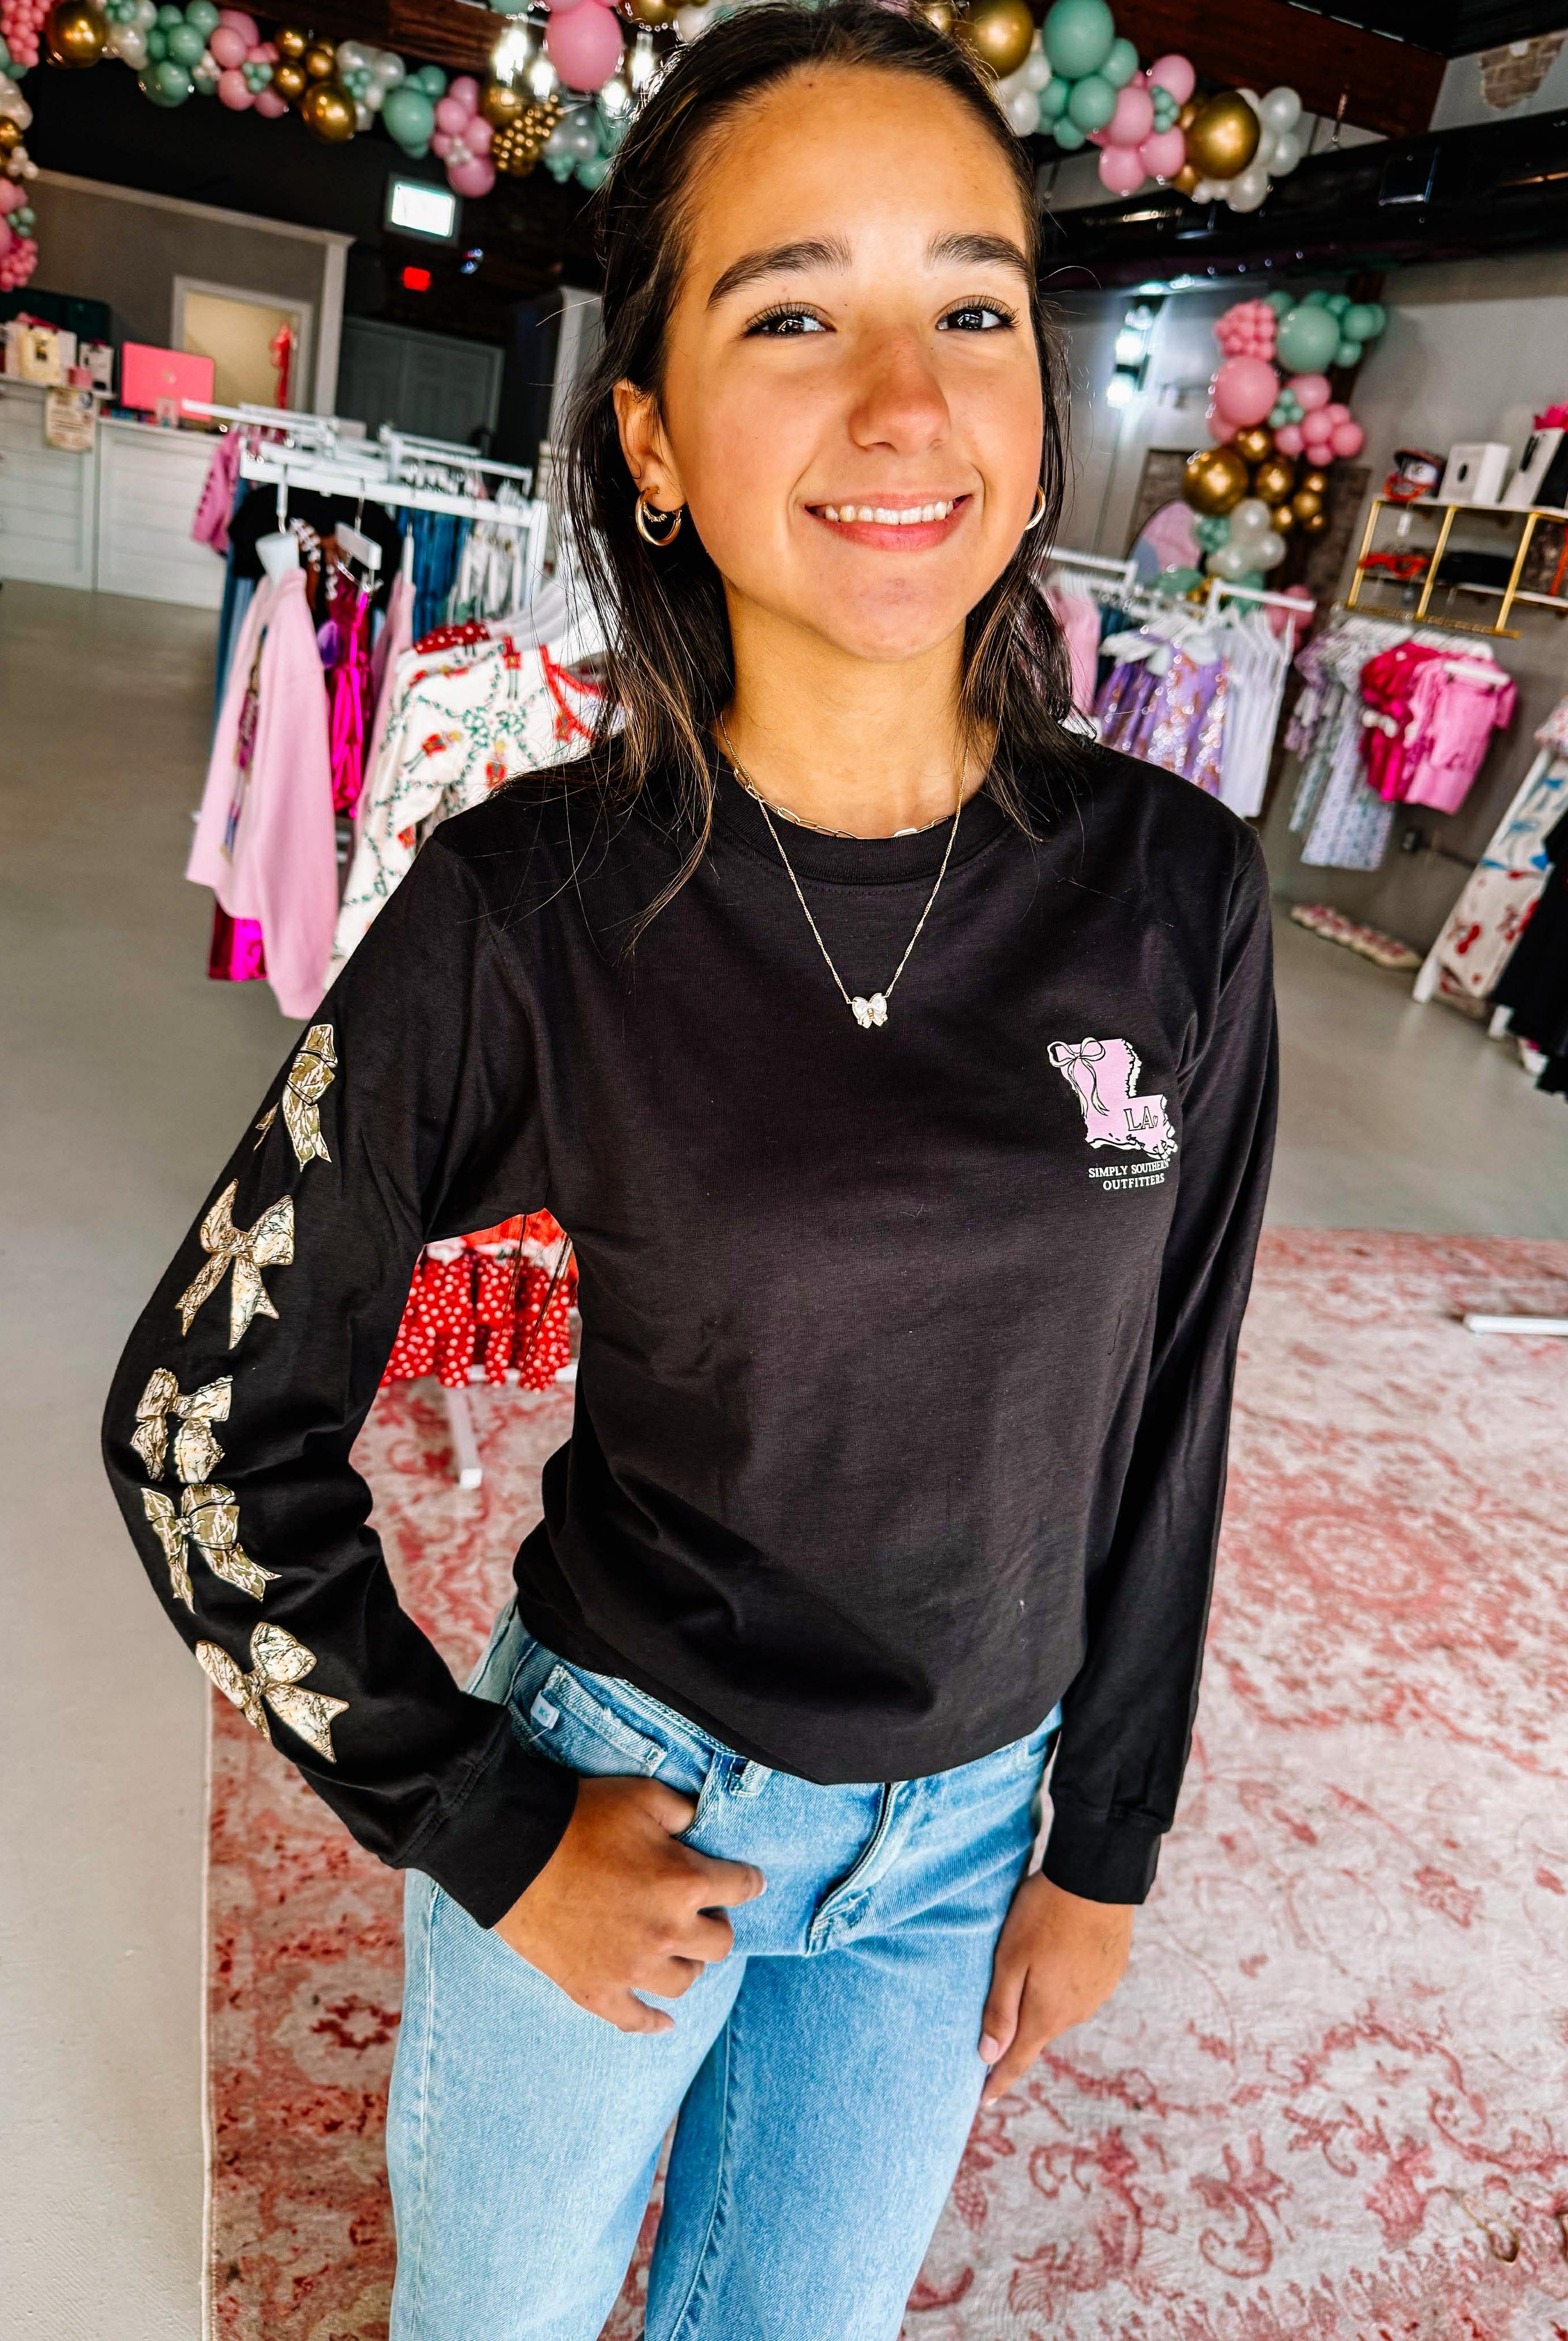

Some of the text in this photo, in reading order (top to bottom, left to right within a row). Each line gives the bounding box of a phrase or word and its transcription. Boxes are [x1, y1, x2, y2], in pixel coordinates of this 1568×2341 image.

[1088, 1159, 1169, 1178] SIMPLY SOUTHERN
[1102, 1173, 1165, 1191] OUTFITTERS
